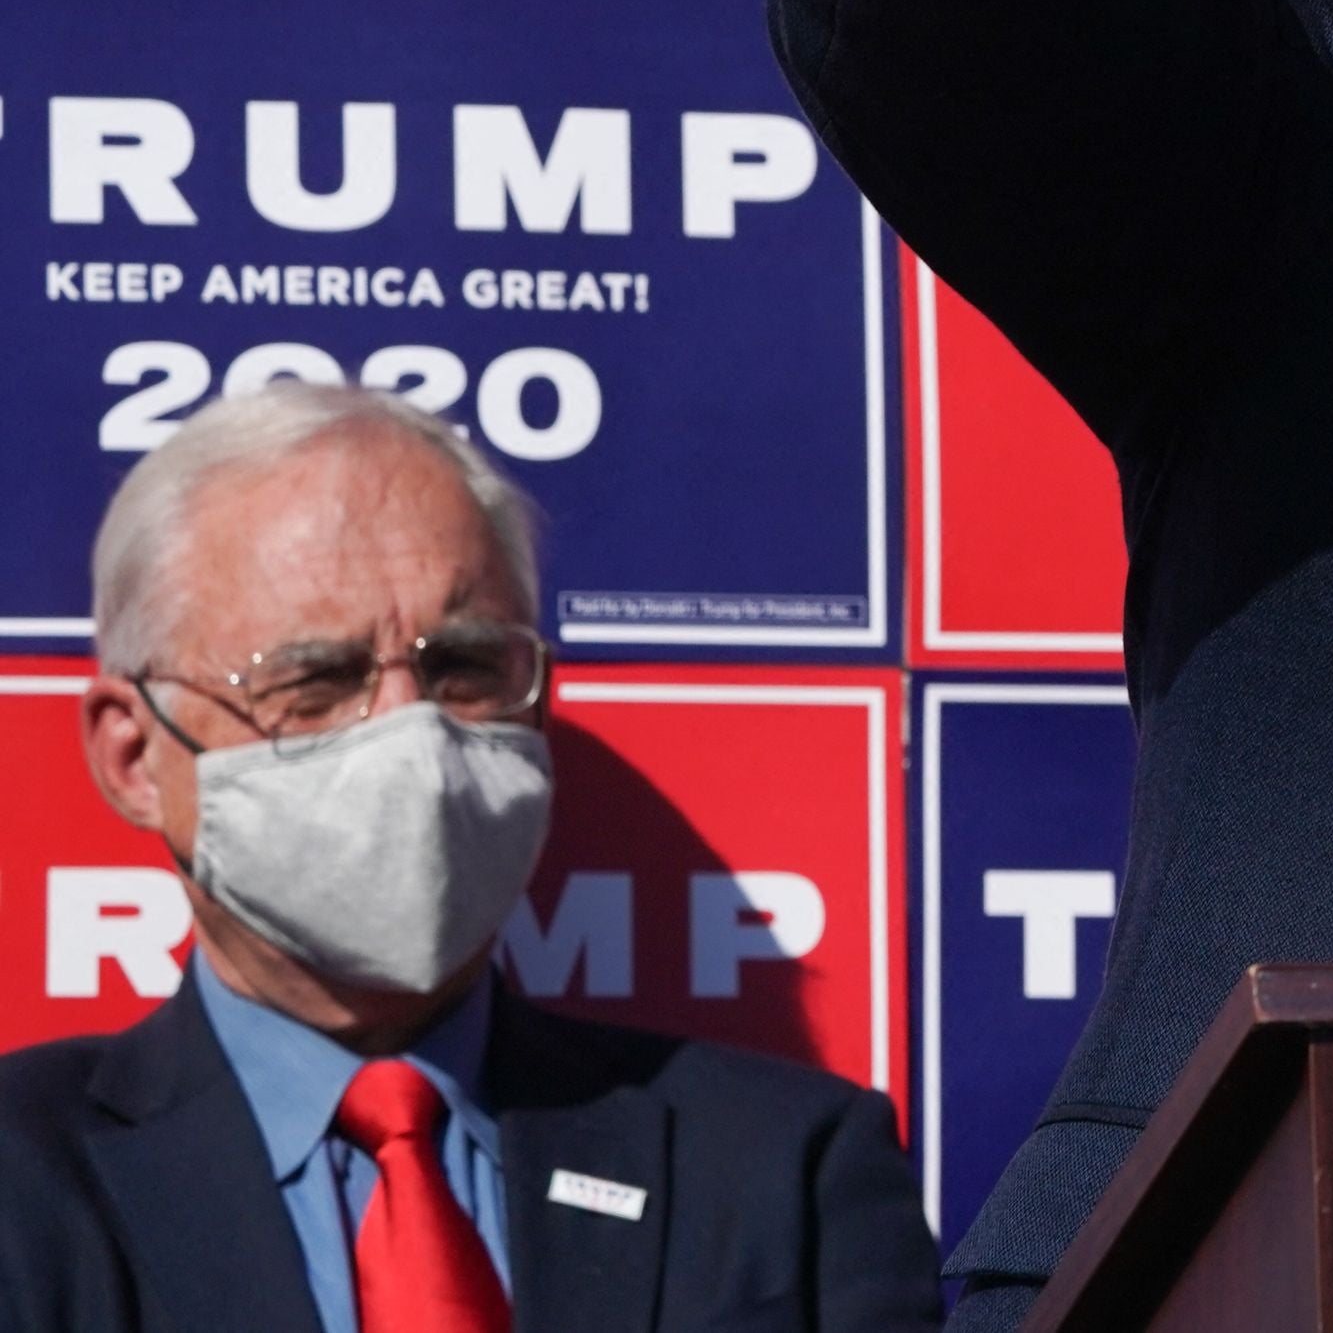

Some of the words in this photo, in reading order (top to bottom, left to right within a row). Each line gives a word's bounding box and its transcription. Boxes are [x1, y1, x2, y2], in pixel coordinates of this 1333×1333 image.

[0, 96, 819, 239] RUMP
[46, 262, 185, 303] KEEP
[201, 263, 446, 308] AMERICA
[461, 267, 650, 314] GREAT!
[45, 866, 827, 999] RMP
